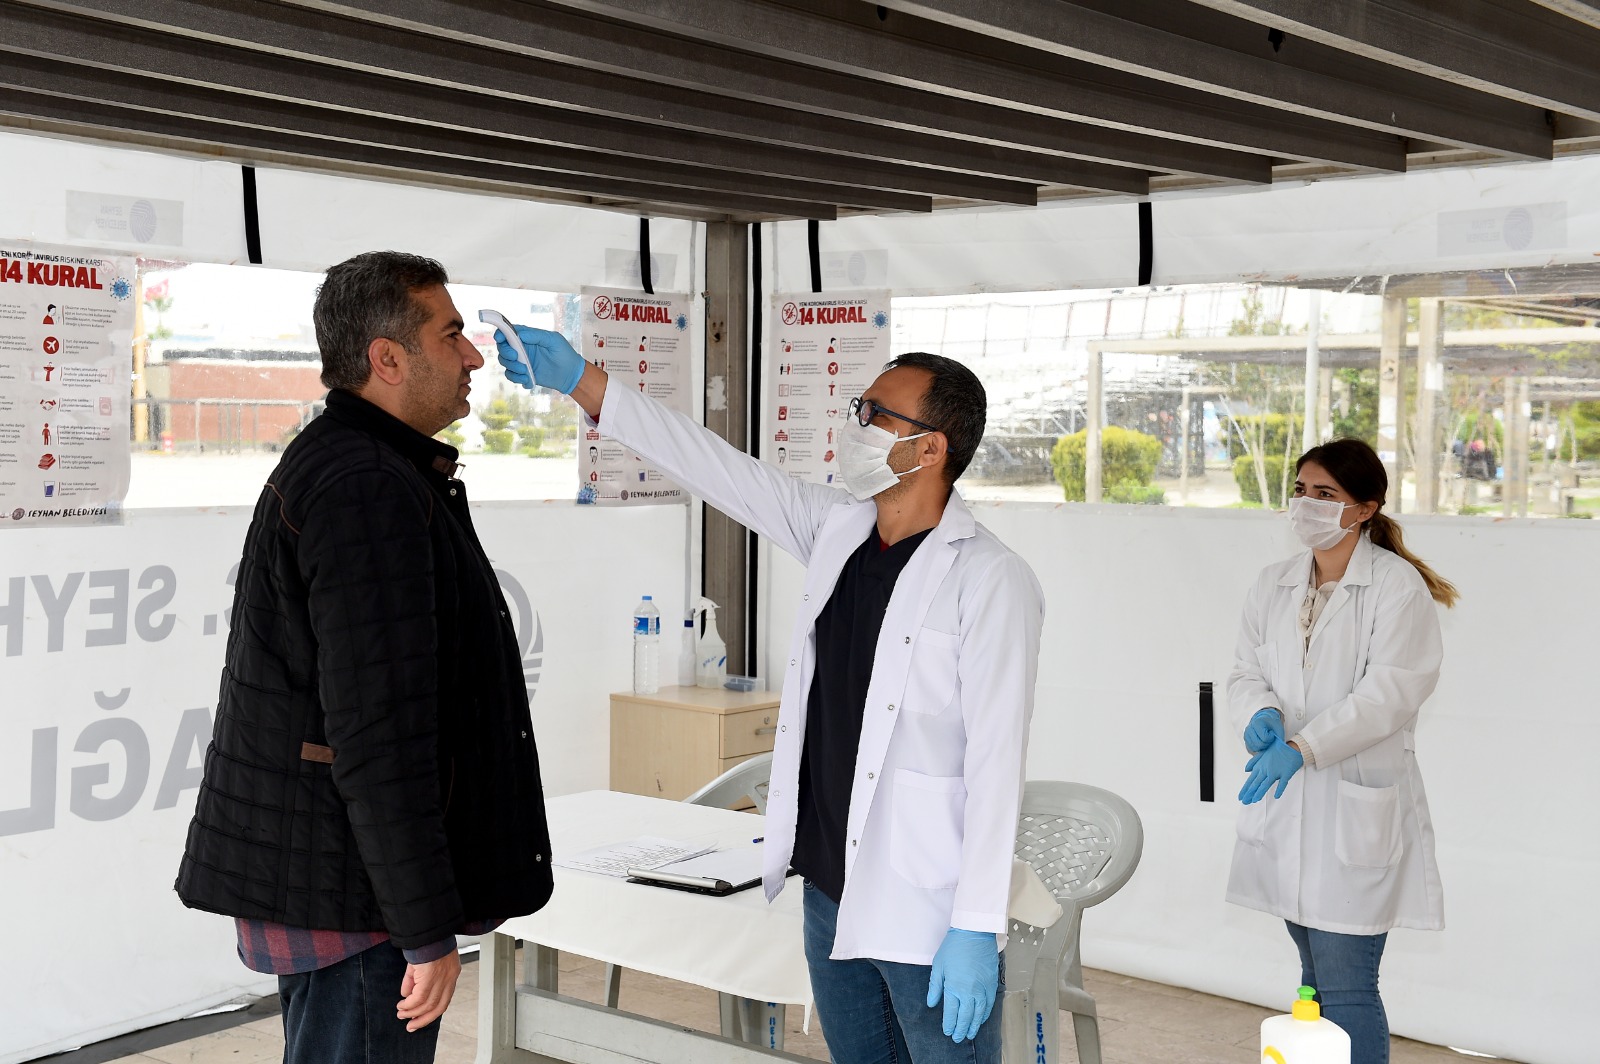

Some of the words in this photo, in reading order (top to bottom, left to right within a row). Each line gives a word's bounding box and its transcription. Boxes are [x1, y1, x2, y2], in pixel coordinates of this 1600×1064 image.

[0, 258, 23, 284] 14
[27, 261, 103, 290] KURAL
[614, 302, 630, 322] 14
[631, 304, 672, 324] KURAL
[799, 307, 815, 326] 14
[817, 306, 868, 325] KURAL
[28, 508, 61, 518] SEYHAN
